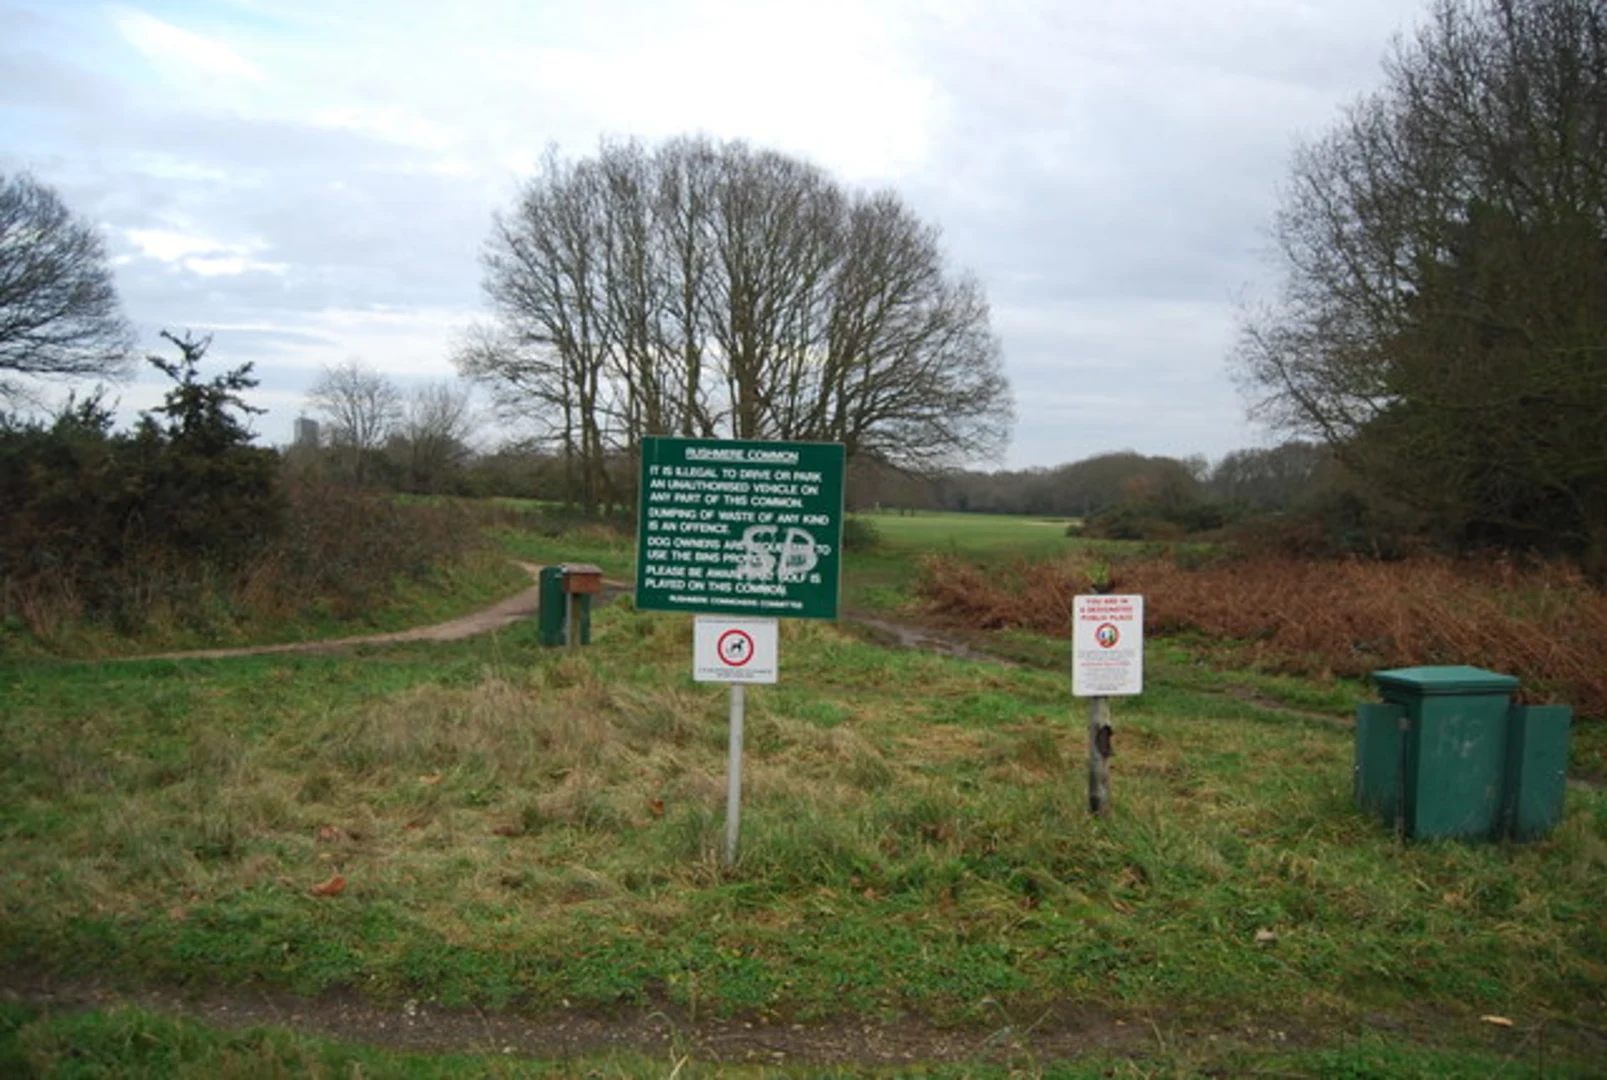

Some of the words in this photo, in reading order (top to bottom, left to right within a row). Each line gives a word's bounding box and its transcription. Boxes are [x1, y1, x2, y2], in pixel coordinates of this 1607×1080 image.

[685, 447, 744, 462] RUSHMERE
[748, 450, 799, 464] COMMON
[650, 466, 659, 475] IT
[663, 466, 673, 476] IS
[676, 467, 718, 477] ILLEGAL
[723, 469, 737, 478] TO
[740, 469, 771, 479] DRIVE
[774, 471, 790, 481] OR
[793, 471, 821, 482] PARK
[650, 480, 665, 489] AN
[668, 480, 750, 492] UNAUTHORISED
[753, 484, 797, 494] VEHICLE
[801, 485, 818, 495] ON
[650, 492, 669, 502] ANY
[675, 493, 700, 503] PART
[705, 495, 720, 504] OF
[724, 496, 747, 505] THIS
[751, 497, 802, 508] COMMON.
[649, 508, 696, 519] DUMPING
[700, 510, 713, 520] OF
[719, 511, 753, 522] WASTE
[759, 512, 774, 522] OF
[777, 513, 799, 523] ANY
[803, 514, 829, 525] KIND
[649, 521, 658, 531] IS
[661, 522, 676, 531] AN
[648, 537, 670, 547] DOG
[673, 538, 720, 549] OWNERS
[817, 545, 831, 555] TO
[648, 551, 667, 561] USE
[672, 552, 691, 561] THE
[696, 553, 720, 563] BINS
[646, 565, 685, 577] PLEASE
[688, 567, 703, 577] BE
[810, 574, 821, 583] IS
[645, 579, 685, 589] PLAYED
[688, 581, 704, 590] ON
[708, 581, 732, 592] THIS
